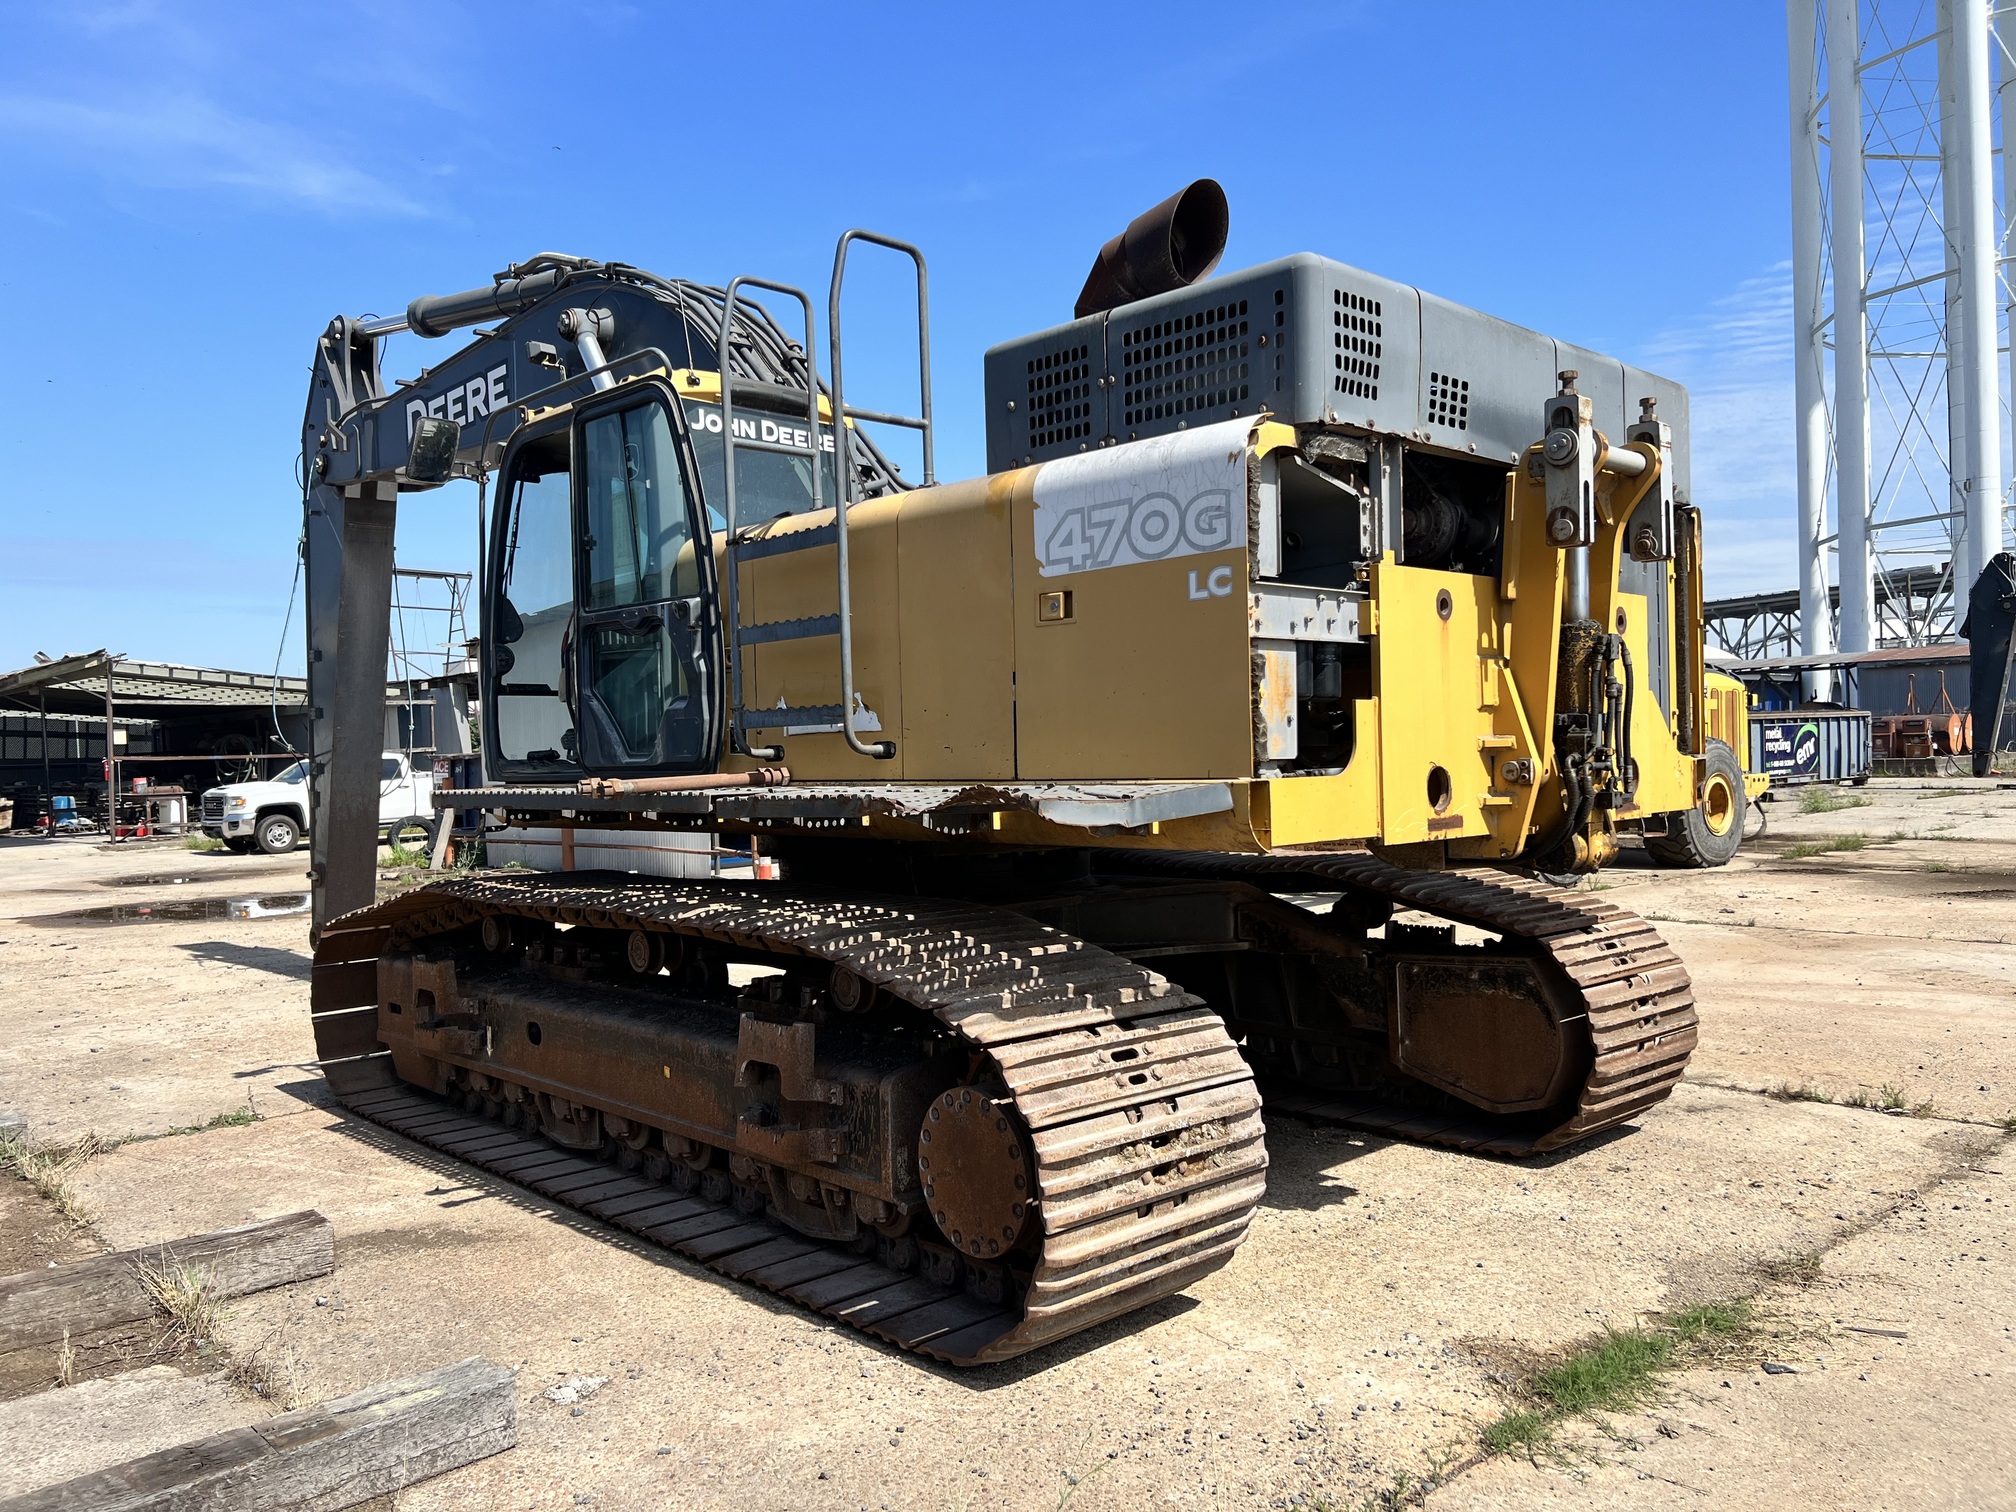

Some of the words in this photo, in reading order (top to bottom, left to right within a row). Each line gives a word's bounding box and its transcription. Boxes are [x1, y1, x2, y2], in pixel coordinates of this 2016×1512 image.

[406, 363, 510, 442] DEERE
[1045, 489, 1232, 572] 470G
[1187, 566, 1233, 600] LC
[434, 761, 449, 773] ACE
[1796, 737, 1816, 765] emr
